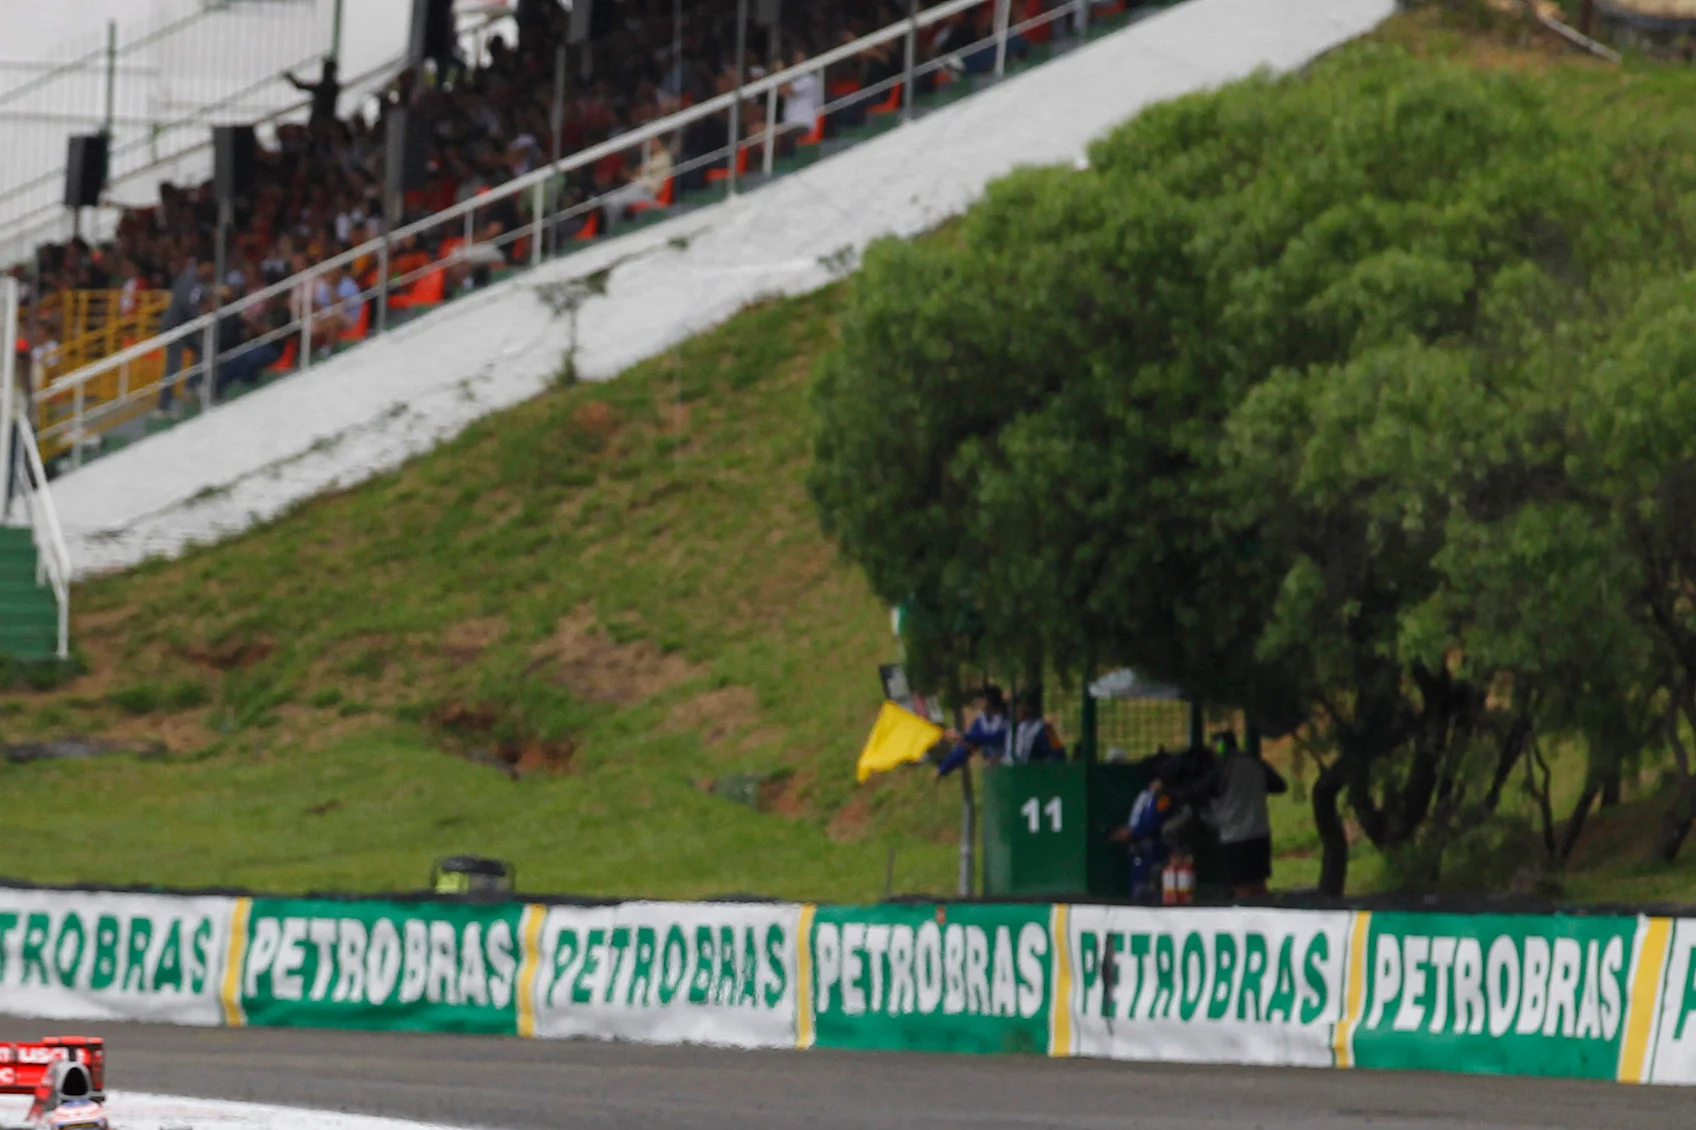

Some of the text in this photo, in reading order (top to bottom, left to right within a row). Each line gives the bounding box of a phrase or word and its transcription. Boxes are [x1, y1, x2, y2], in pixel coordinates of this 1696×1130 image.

[1020, 796, 1063, 834] 11
[244, 916, 516, 1009] PETROBRAS
[547, 923, 785, 1008] PETROBRAS
[816, 921, 1048, 1019] PETROBRAS
[1081, 931, 1328, 1024] PETROBRAS
[1366, 933, 1624, 1041] PETROBRAS
